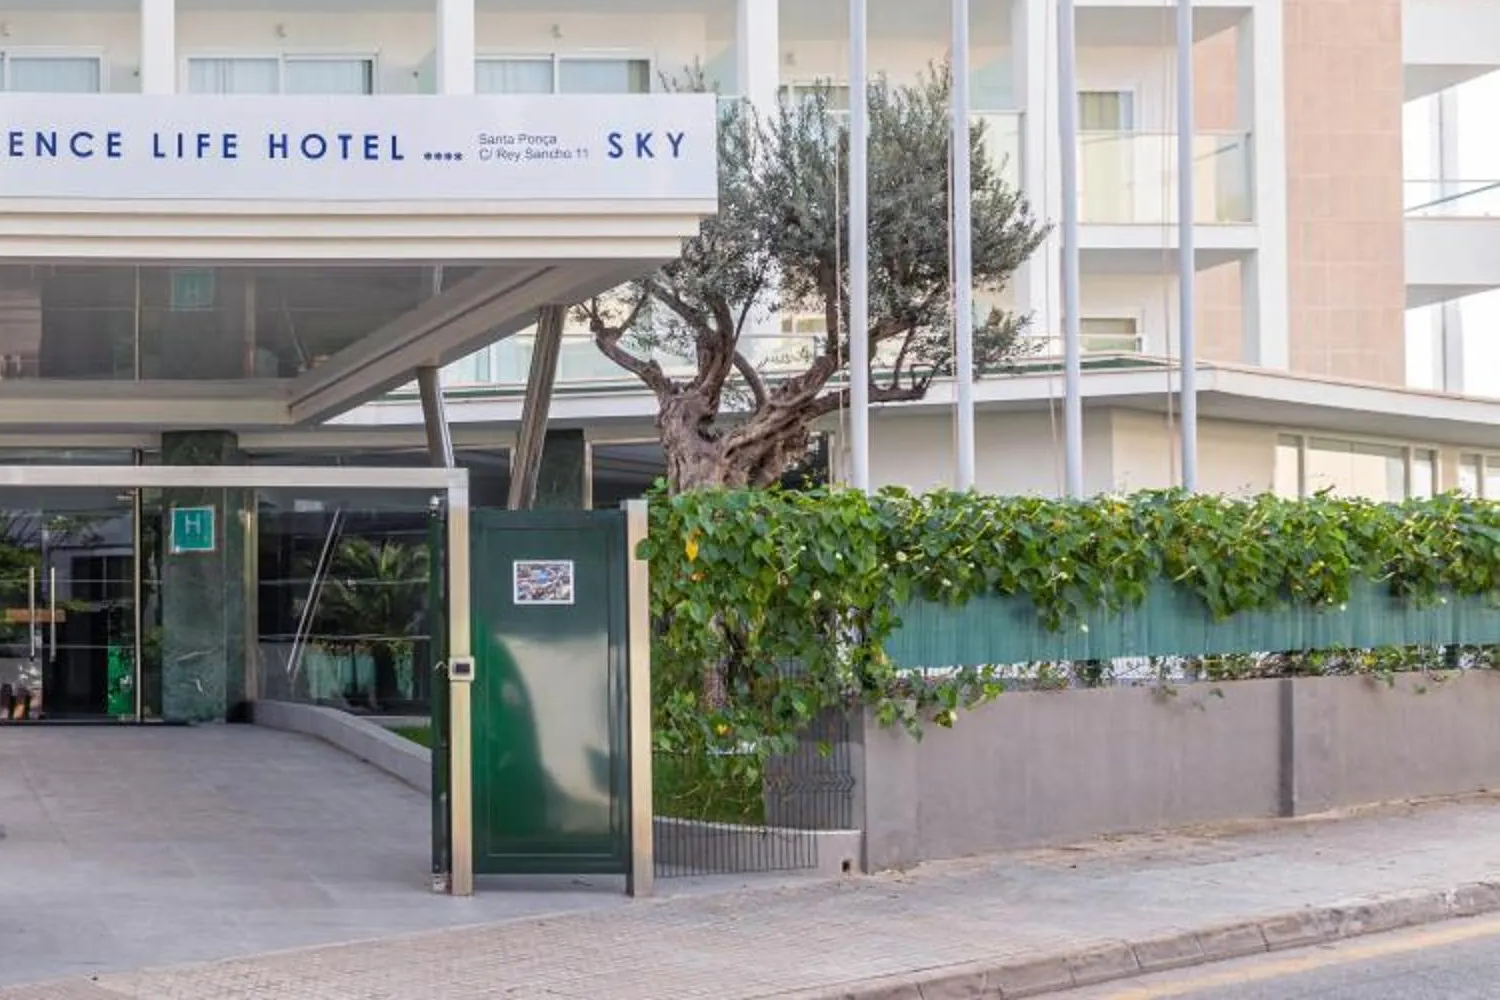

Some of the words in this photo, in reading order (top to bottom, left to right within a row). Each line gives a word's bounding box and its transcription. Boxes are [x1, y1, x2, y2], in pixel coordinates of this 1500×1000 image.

[153, 132, 238, 158] LIFE
[268, 133, 405, 160] HOTEL
[479, 134, 513, 145] Santa
[607, 132, 685, 159] SKY
[497, 149, 521, 162] Rey
[525, 148, 573, 160] Sancho
[577, 149, 590, 159] 11
[184, 513, 201, 536] H
